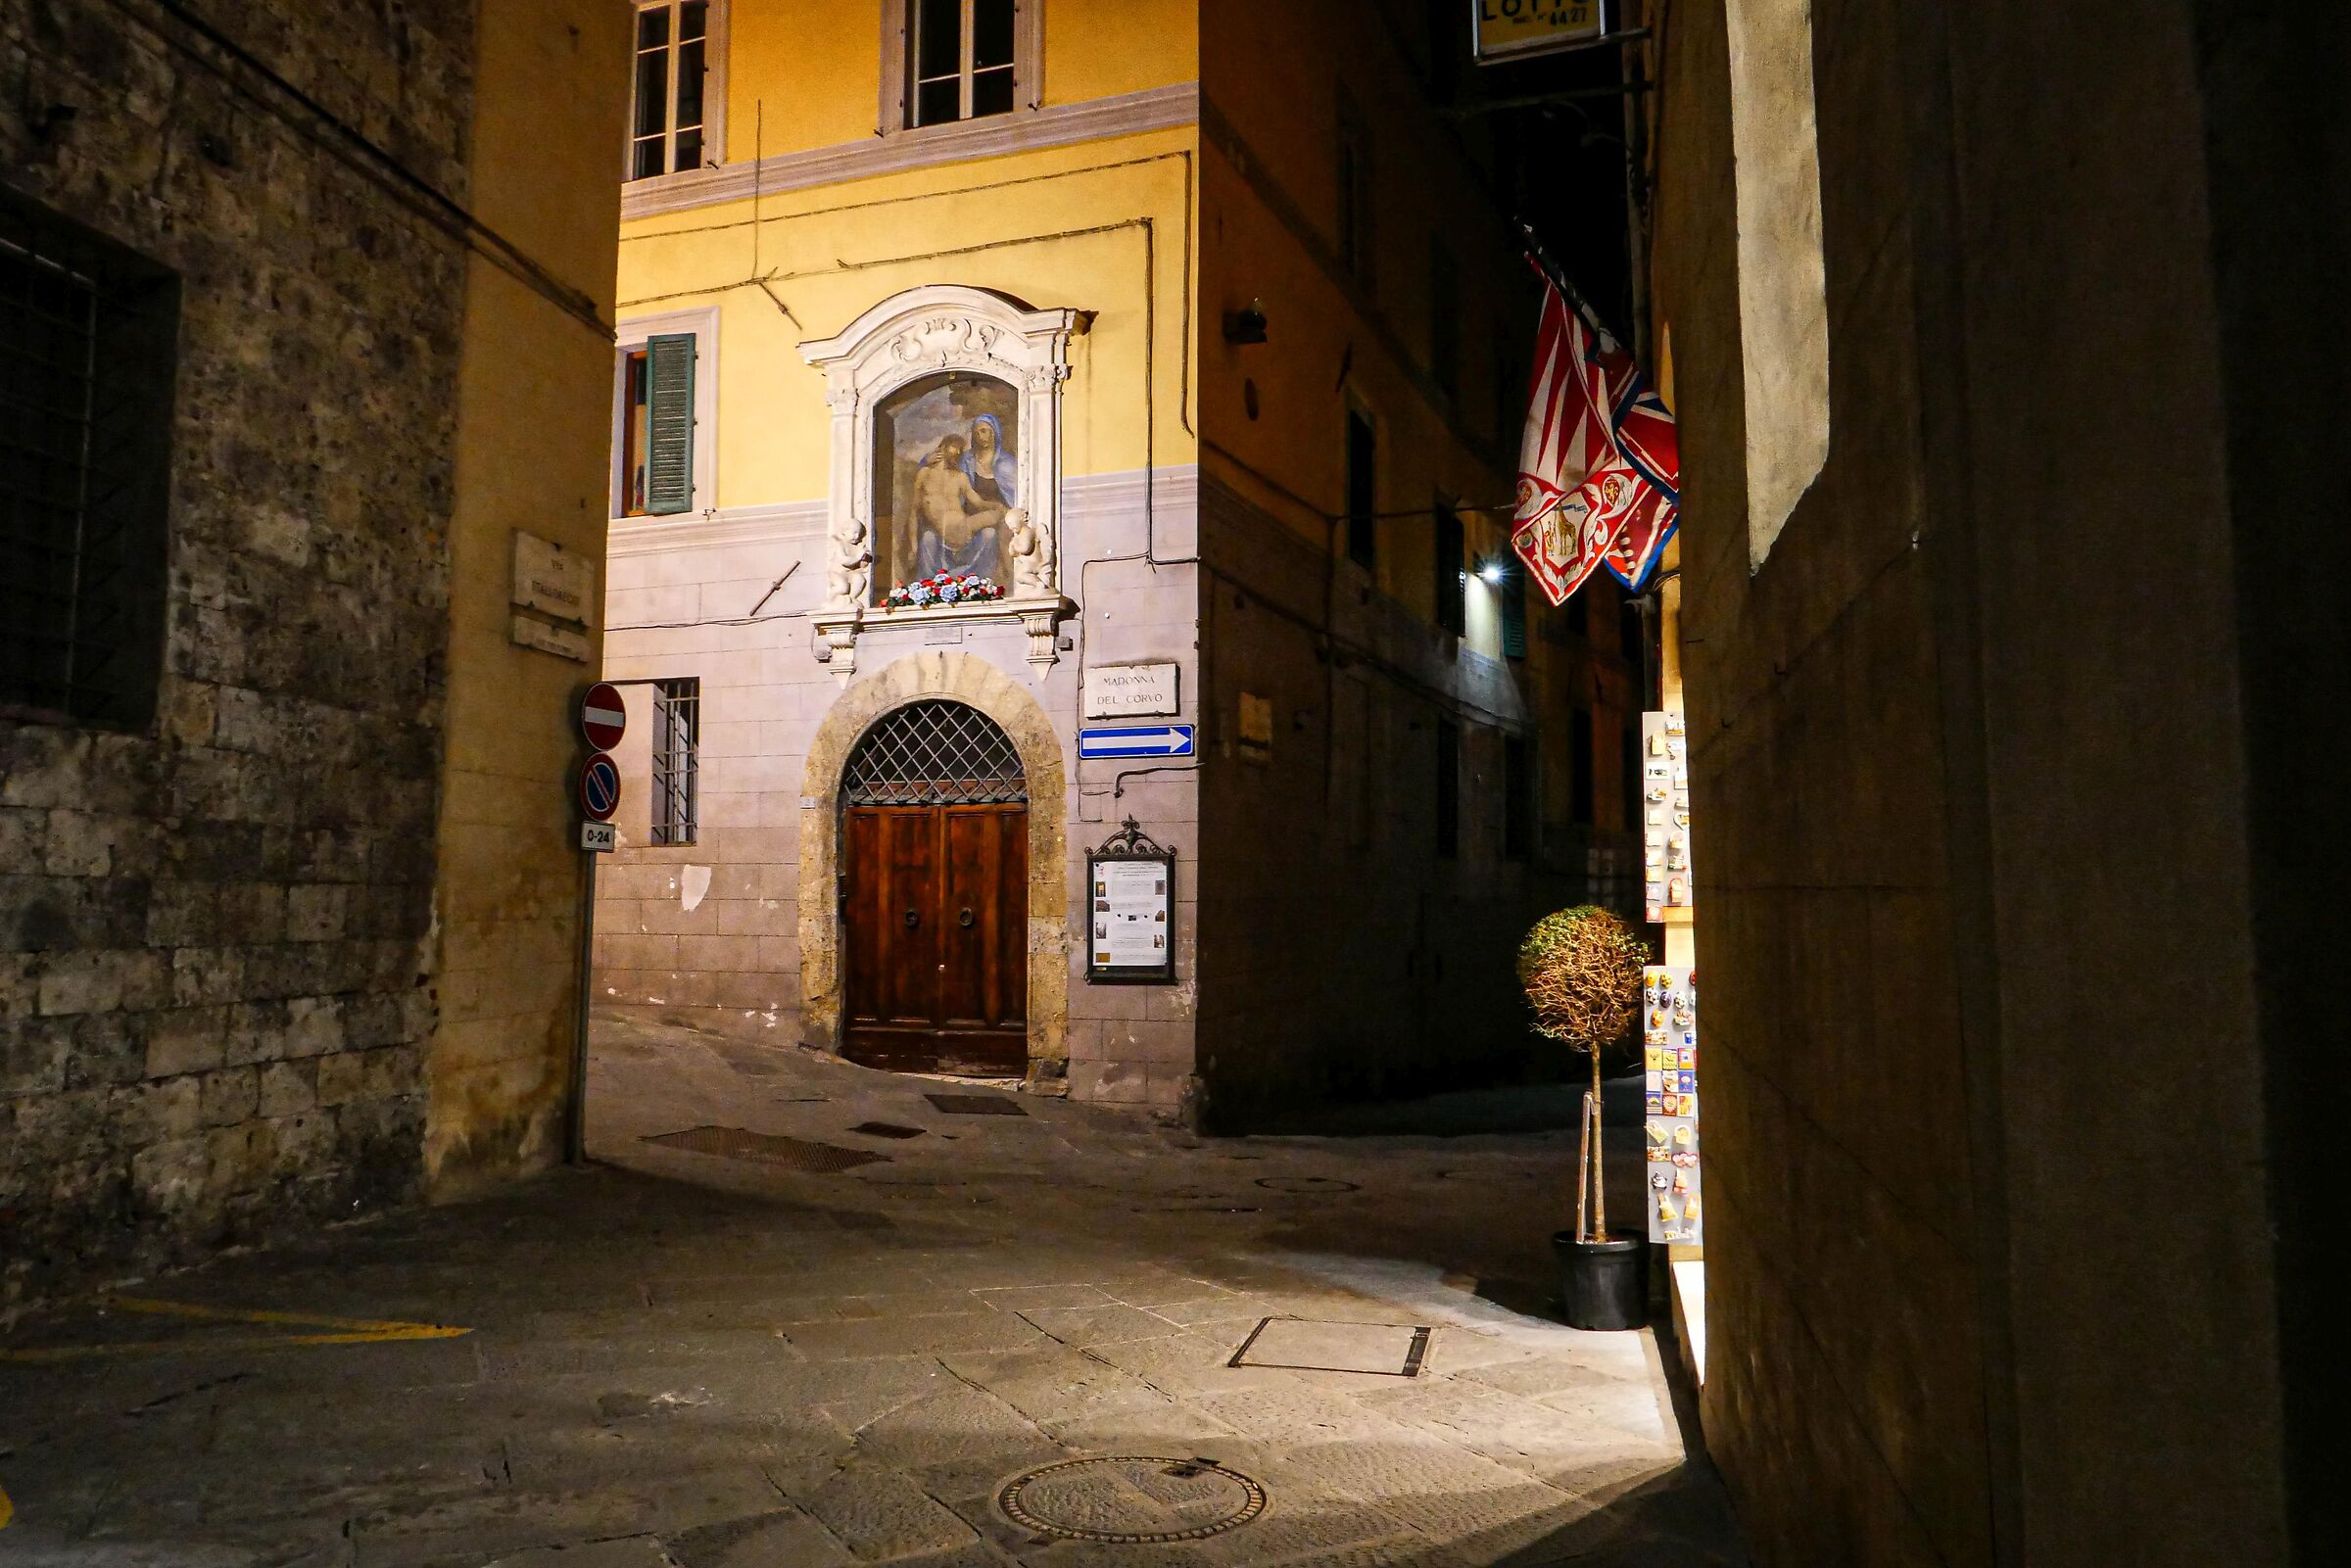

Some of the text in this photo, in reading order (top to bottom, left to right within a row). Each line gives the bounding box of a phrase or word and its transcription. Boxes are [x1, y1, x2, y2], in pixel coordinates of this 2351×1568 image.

[1103, 675, 1155, 687] MADONNA
[1097, 693, 1163, 706] DEL CORVO
[587, 829, 610, 843] 0-24
